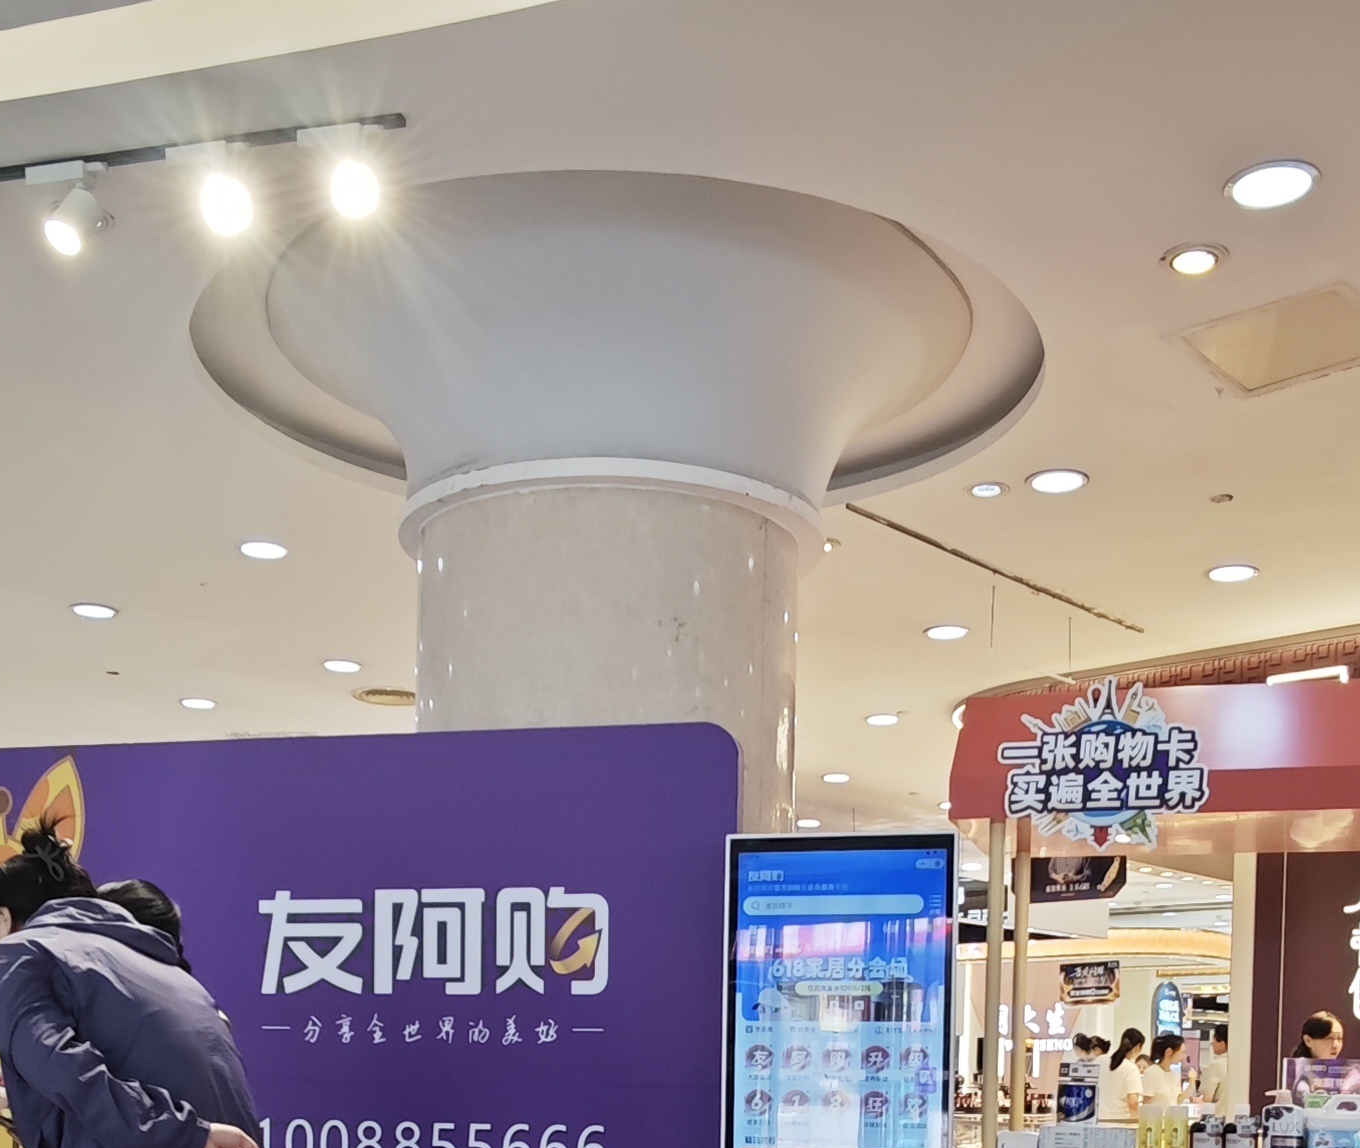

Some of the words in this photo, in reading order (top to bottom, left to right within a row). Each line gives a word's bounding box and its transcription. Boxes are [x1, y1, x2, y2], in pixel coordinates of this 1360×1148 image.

[1003, 729, 1195, 771] 一张购物卡
[1010, 769, 1204, 811] 买遍全世界
[259, 886, 609, 996] 友阿购
[302, 1013, 559, 1046] 分享全世界的美好
[1272, 1121, 1301, 1133] LUX
